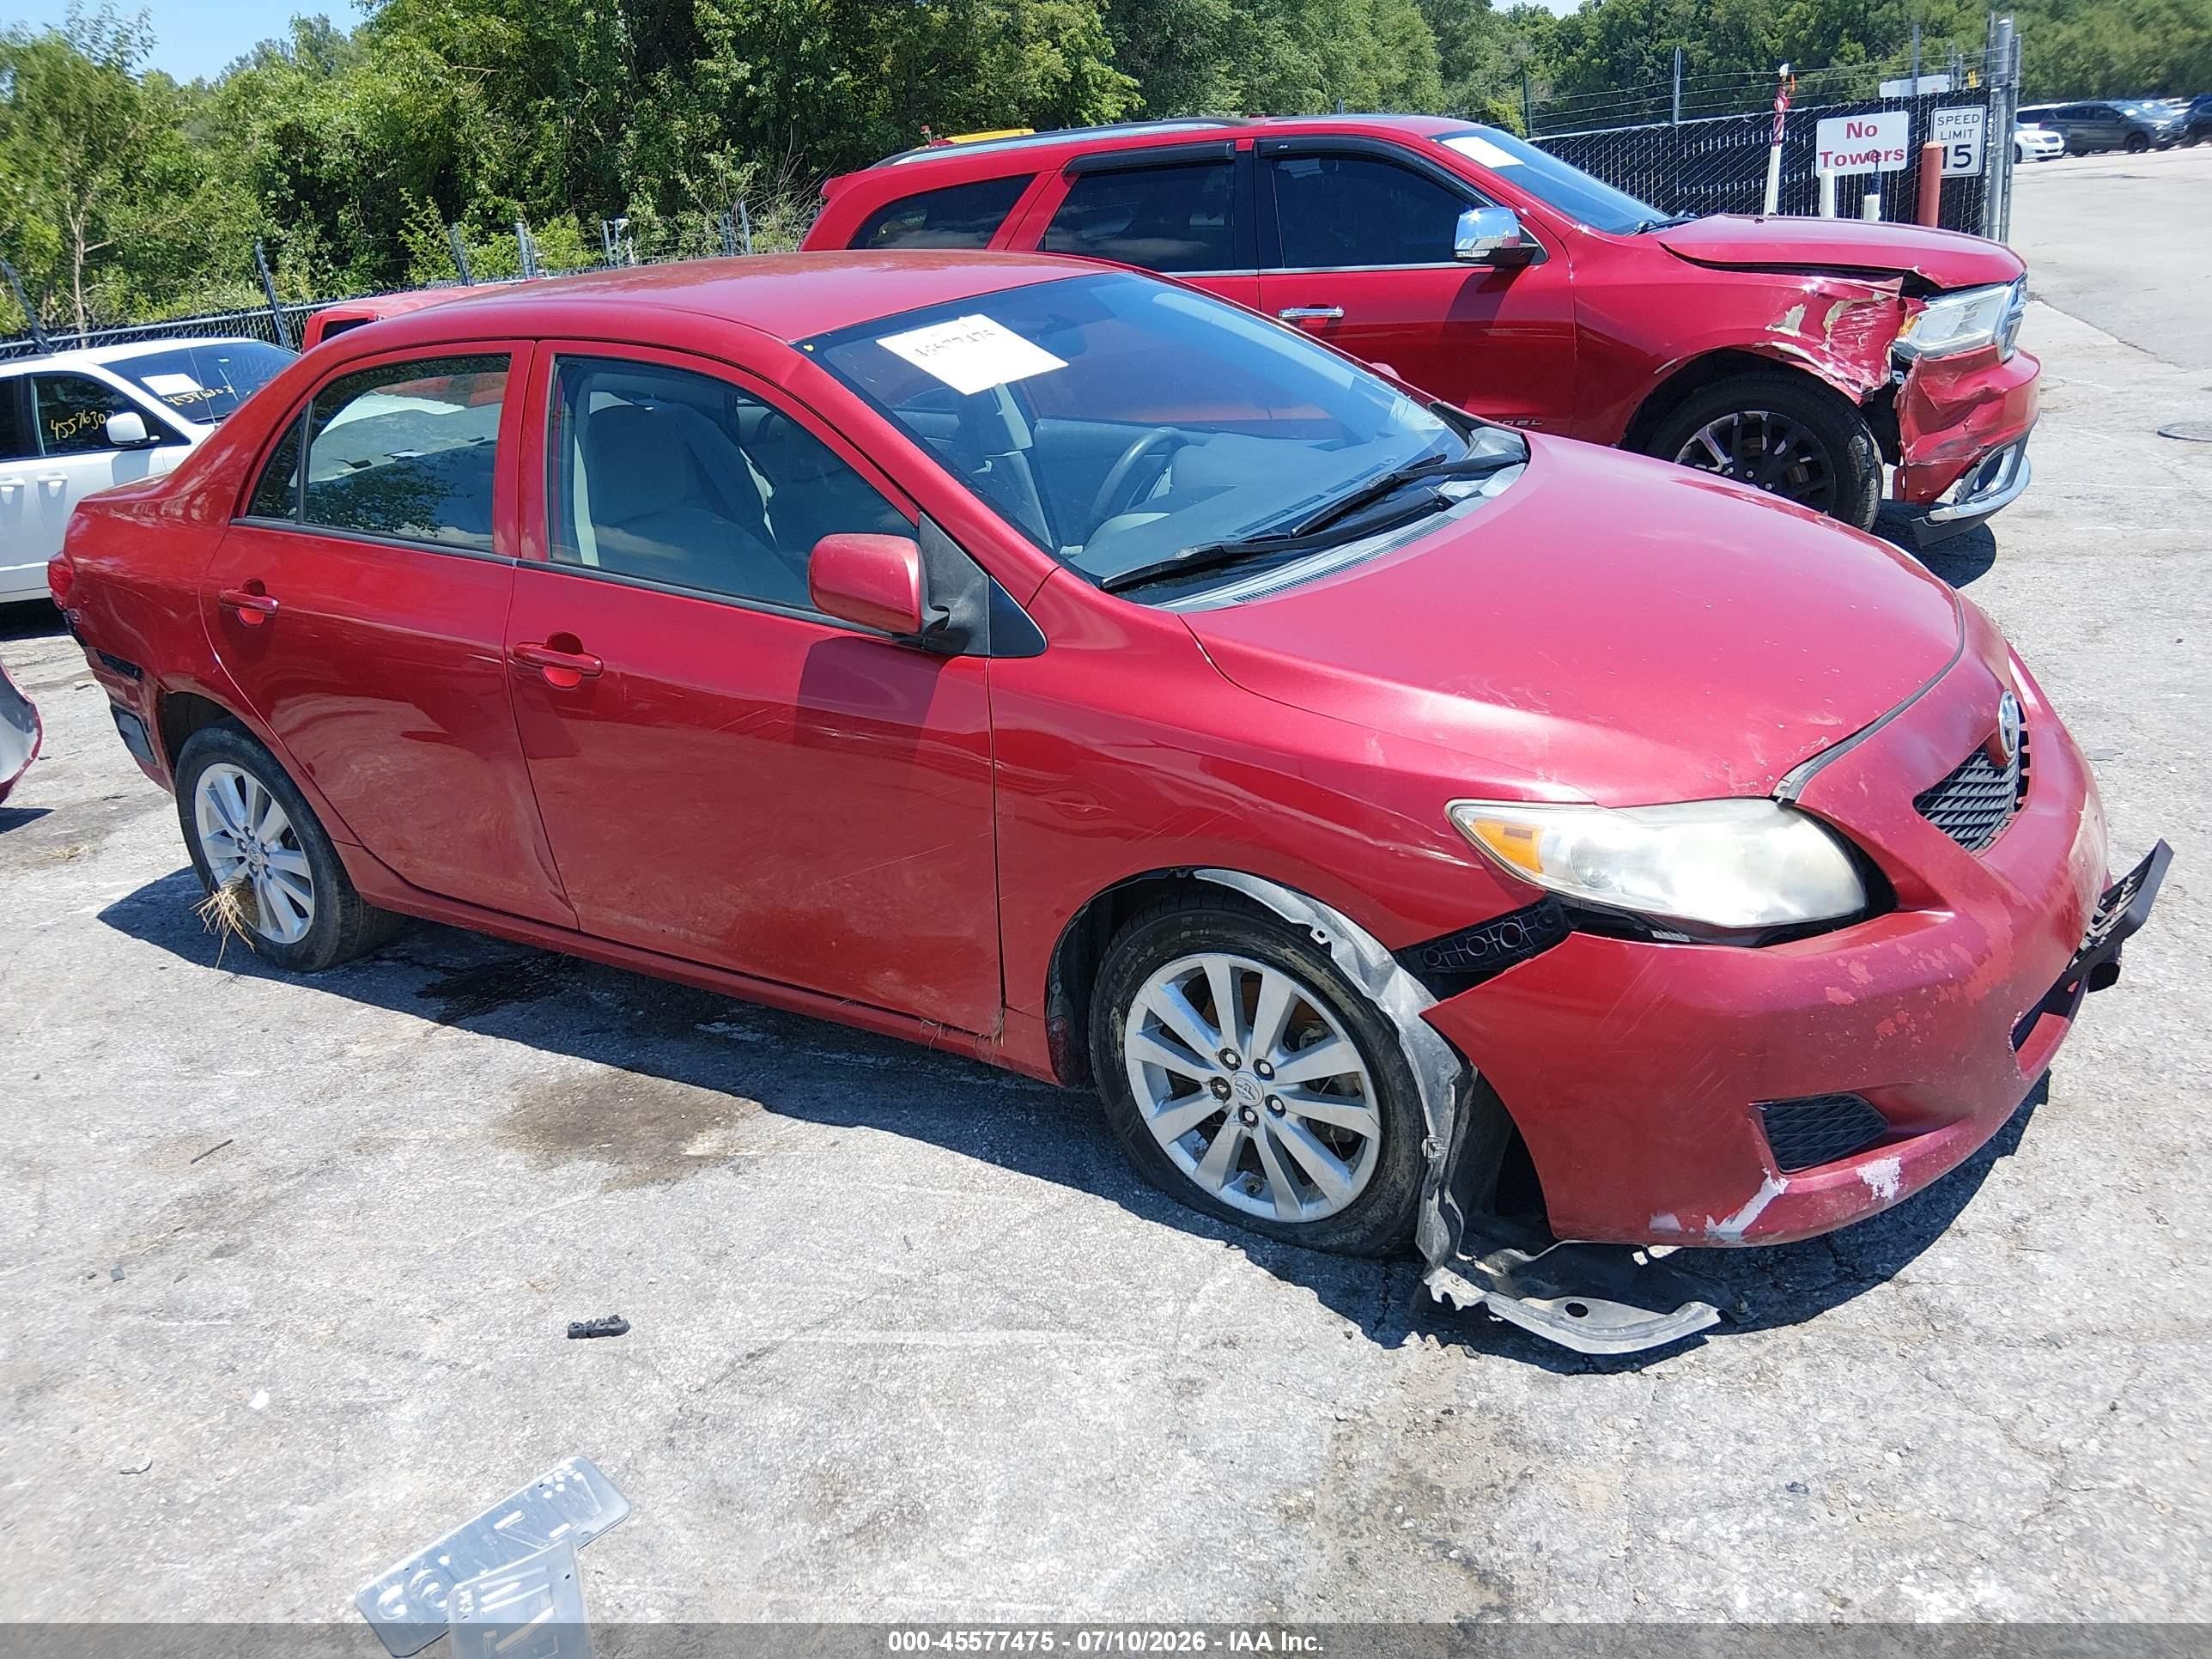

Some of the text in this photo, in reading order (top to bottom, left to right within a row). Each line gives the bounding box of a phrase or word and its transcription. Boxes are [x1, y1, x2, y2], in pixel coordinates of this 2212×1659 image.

[1936, 113, 1980, 126] SPEED
[1845, 121, 1878, 139] No
[1940, 128, 1975, 141] LIMIT
[1819, 147, 1905, 168] Towers
[1942, 143, 1972, 170] 15
